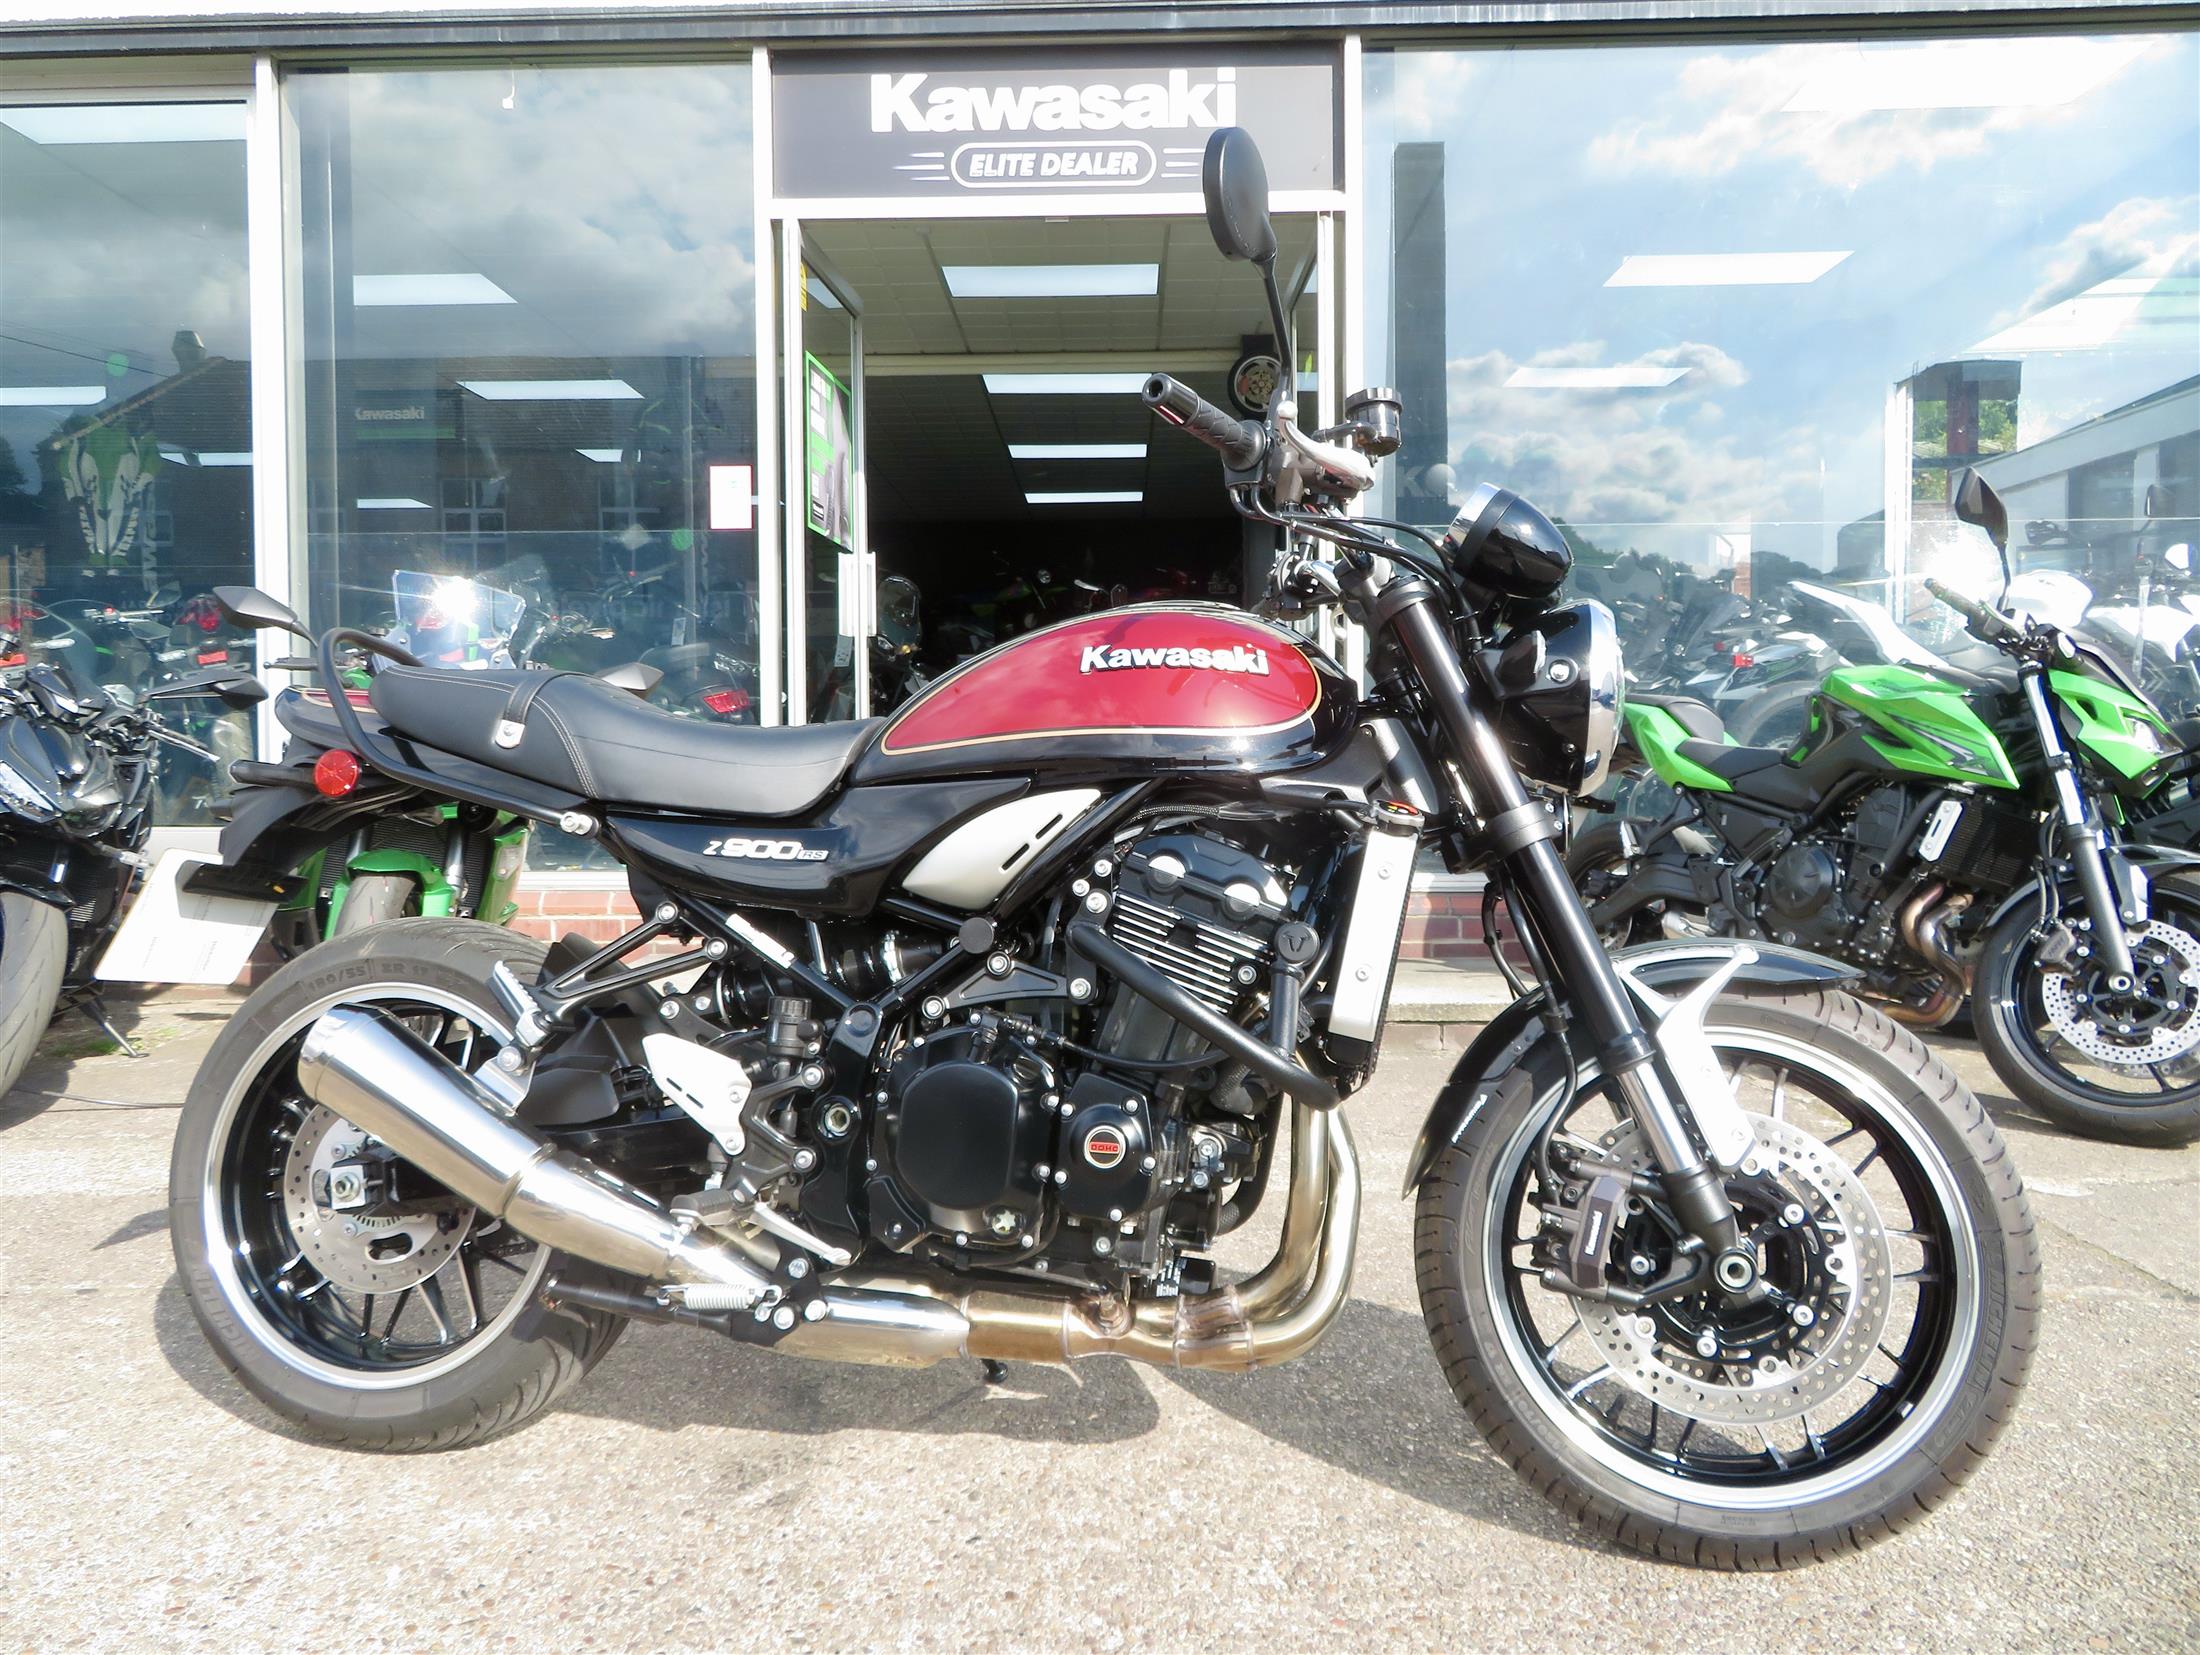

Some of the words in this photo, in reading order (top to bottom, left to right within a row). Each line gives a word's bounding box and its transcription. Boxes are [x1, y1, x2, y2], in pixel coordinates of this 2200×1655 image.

[870, 66, 1236, 133] Kawasaki
[969, 152, 1036, 177] ELITE
[1040, 151, 1138, 176] DEALER
[1079, 644, 1270, 677] Kawasaki
